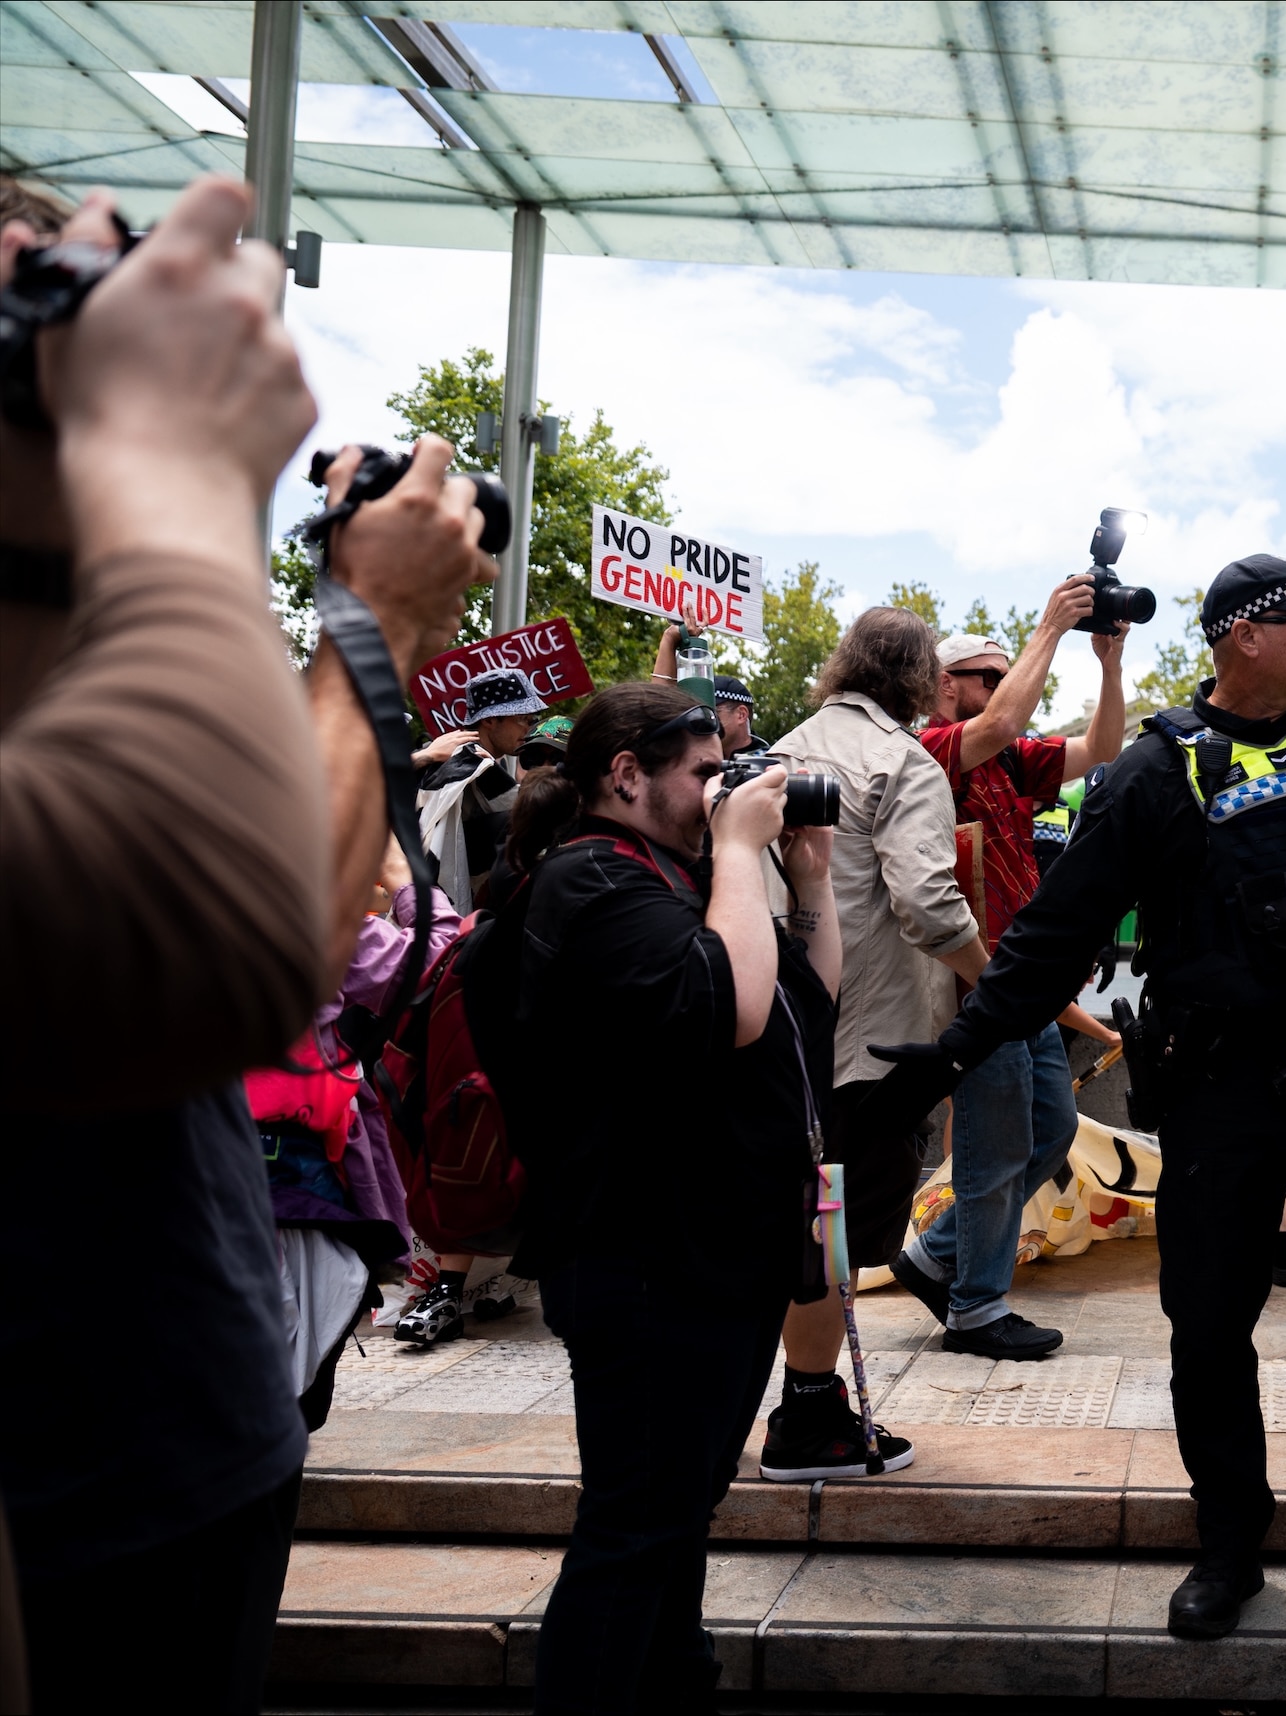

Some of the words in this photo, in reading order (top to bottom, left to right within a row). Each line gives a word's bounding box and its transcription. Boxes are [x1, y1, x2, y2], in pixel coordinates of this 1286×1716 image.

[603, 514, 650, 560] NO
[670, 535, 750, 593] PRIDE
[600, 555, 743, 633] GENOCIDE
[418, 660, 471, 700] NO
[468, 625, 566, 672] JUSTICE
